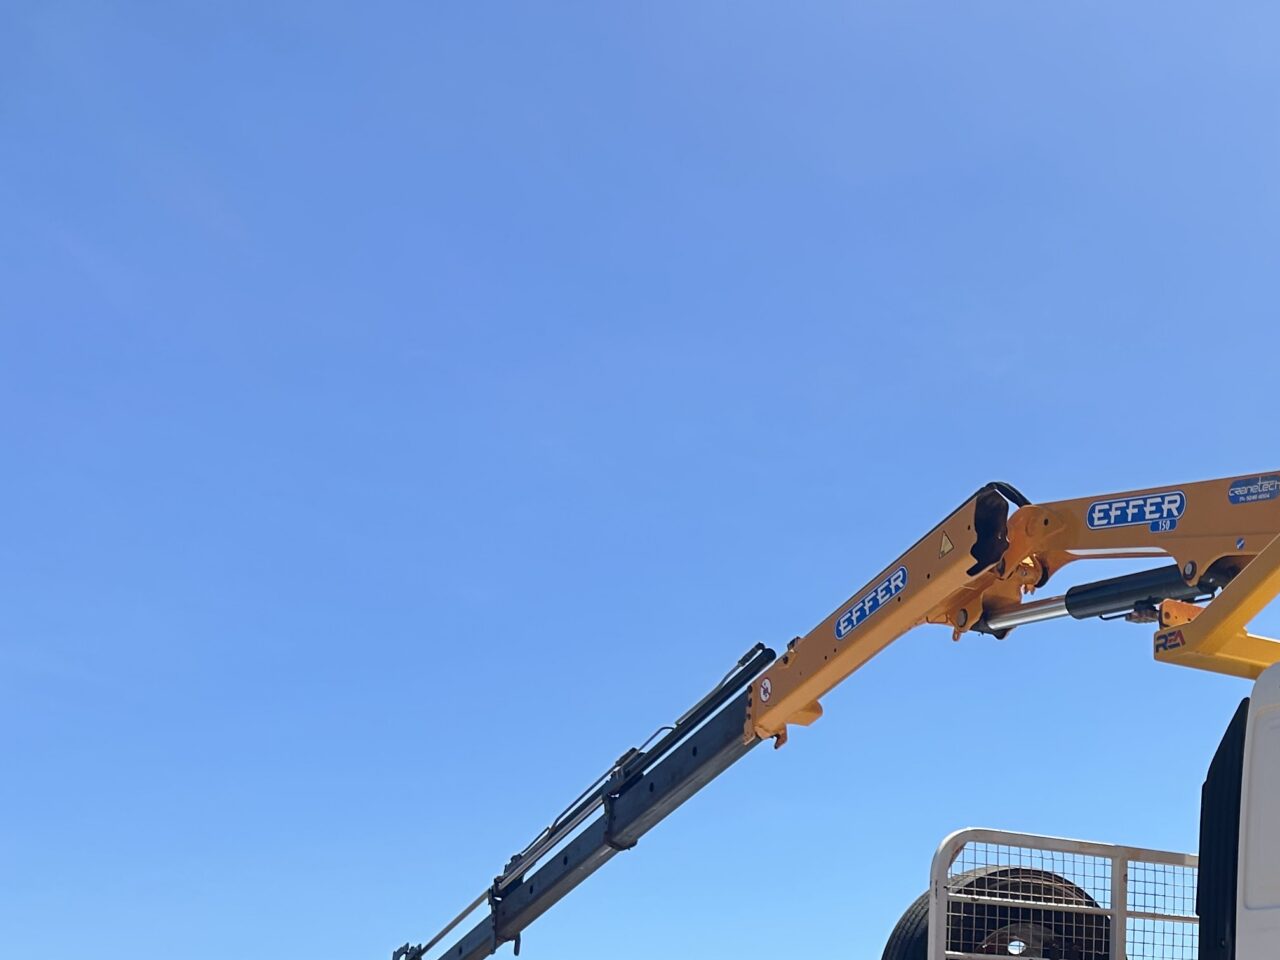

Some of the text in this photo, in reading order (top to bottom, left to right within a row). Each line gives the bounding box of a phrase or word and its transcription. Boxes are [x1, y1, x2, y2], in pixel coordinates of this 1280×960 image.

[1092, 495, 1181, 526] EFFER
[1158, 519, 1171, 531] 150
[839, 570, 904, 636] EFFER
